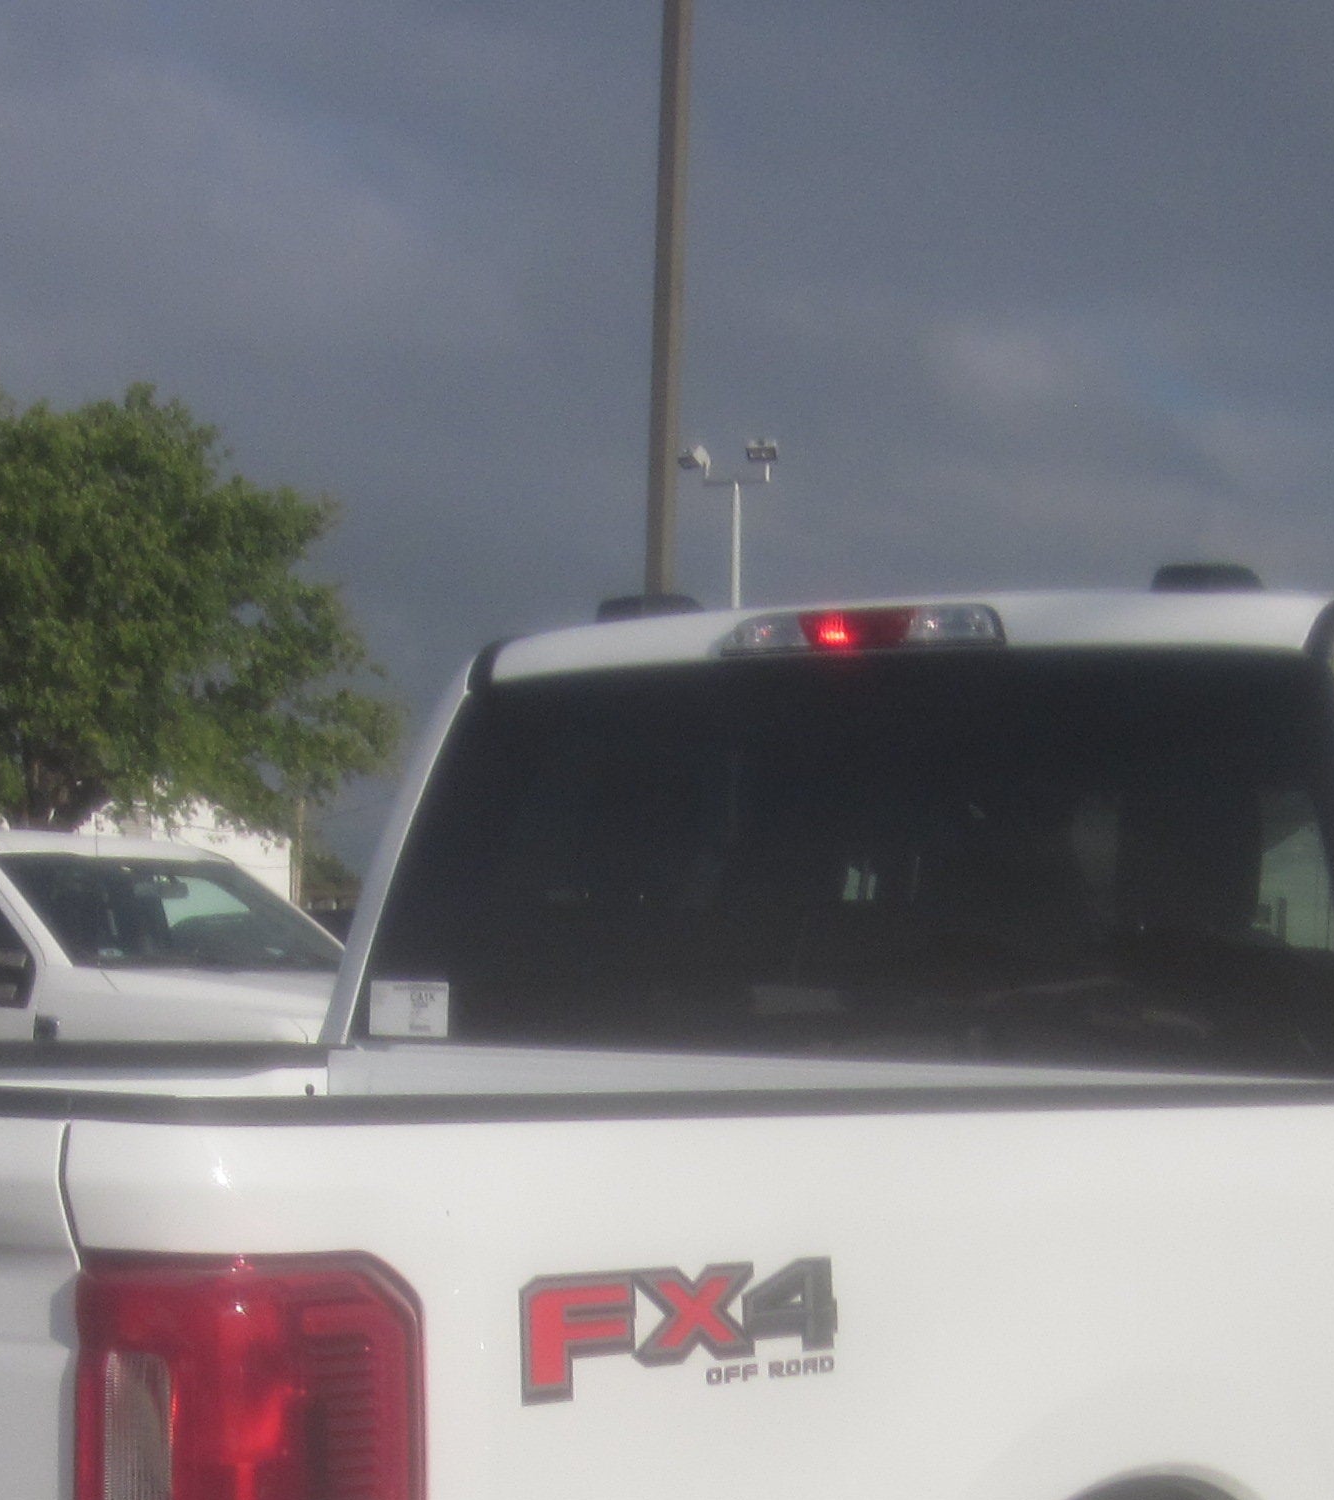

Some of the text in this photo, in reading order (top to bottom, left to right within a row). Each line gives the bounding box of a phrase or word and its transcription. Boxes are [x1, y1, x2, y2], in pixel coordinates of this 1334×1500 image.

[518, 1255, 838, 1407] FX4
[705, 1355, 835, 1386] OFF ROAD
